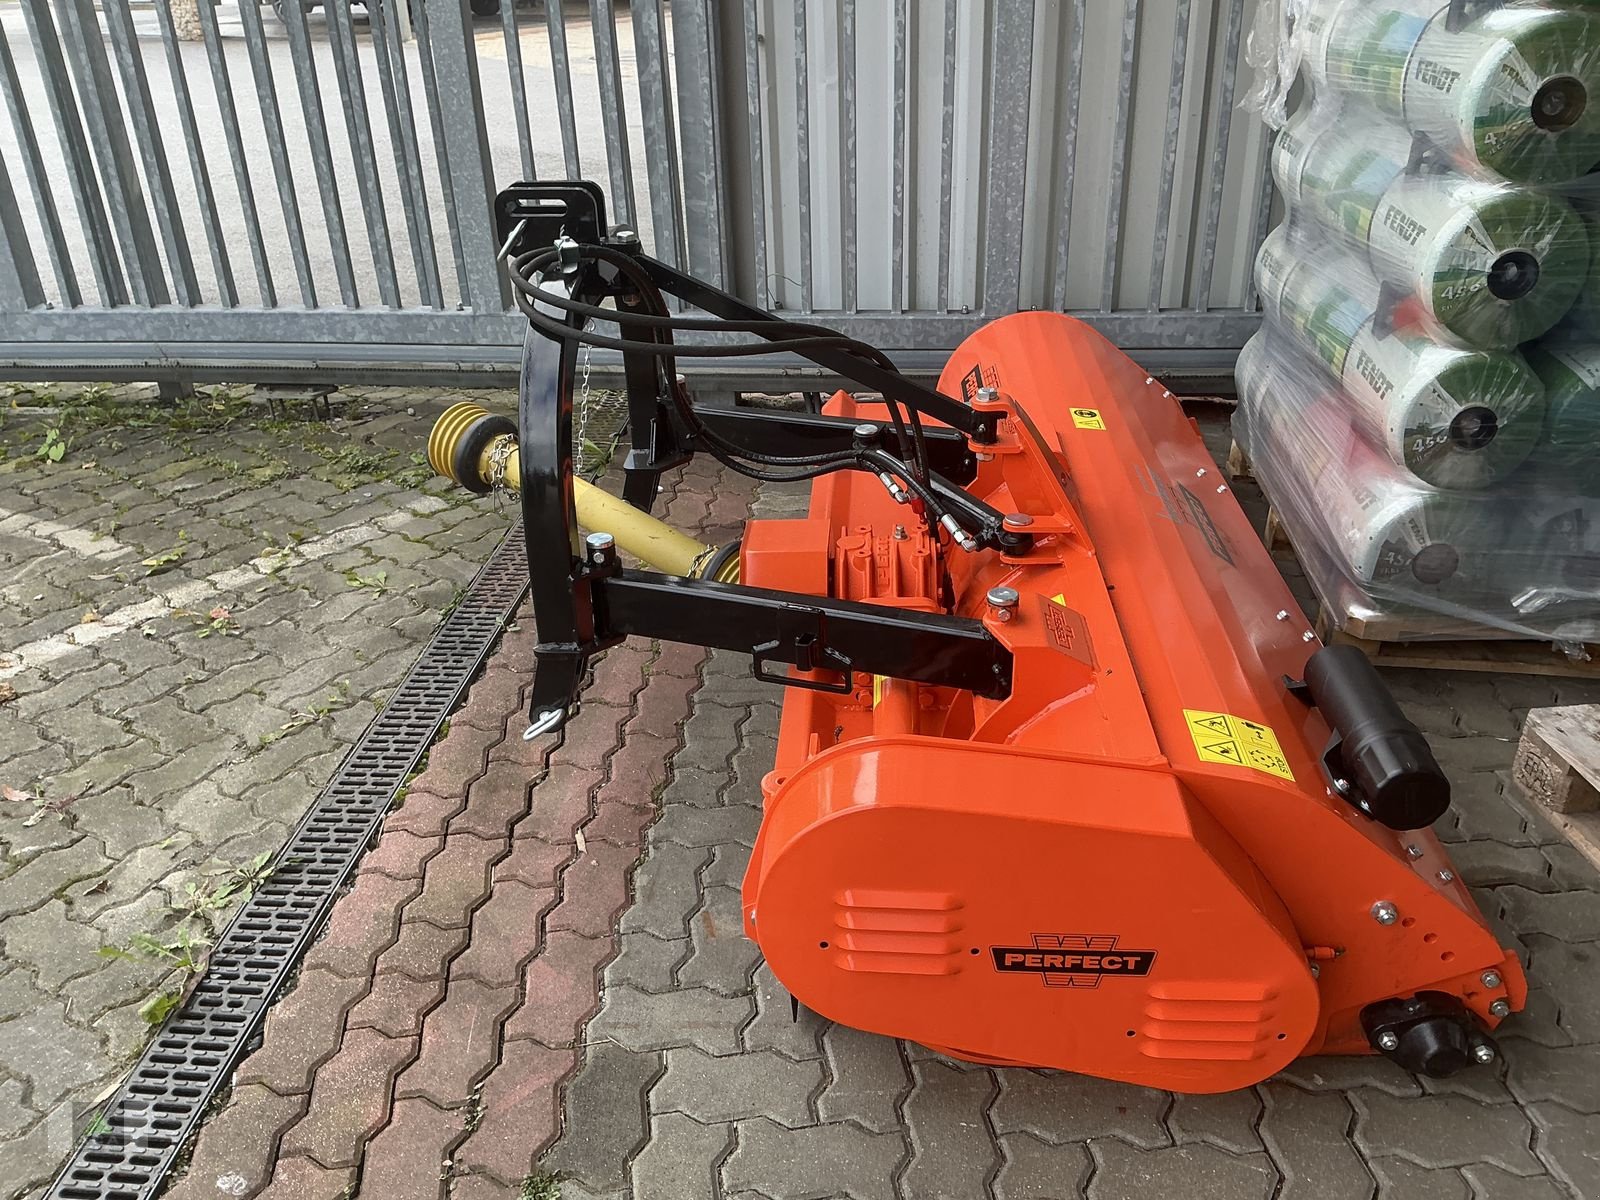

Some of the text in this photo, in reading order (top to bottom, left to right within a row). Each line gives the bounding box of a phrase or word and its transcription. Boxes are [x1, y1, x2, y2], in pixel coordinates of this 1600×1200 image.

[1414, 59, 1461, 94] FENDT
[1383, 204, 1427, 246] FENDT
[1356, 348, 1395, 400] FENDT
[1408, 517, 1427, 548] FEND
[1004, 953, 1142, 970] PERFECT
